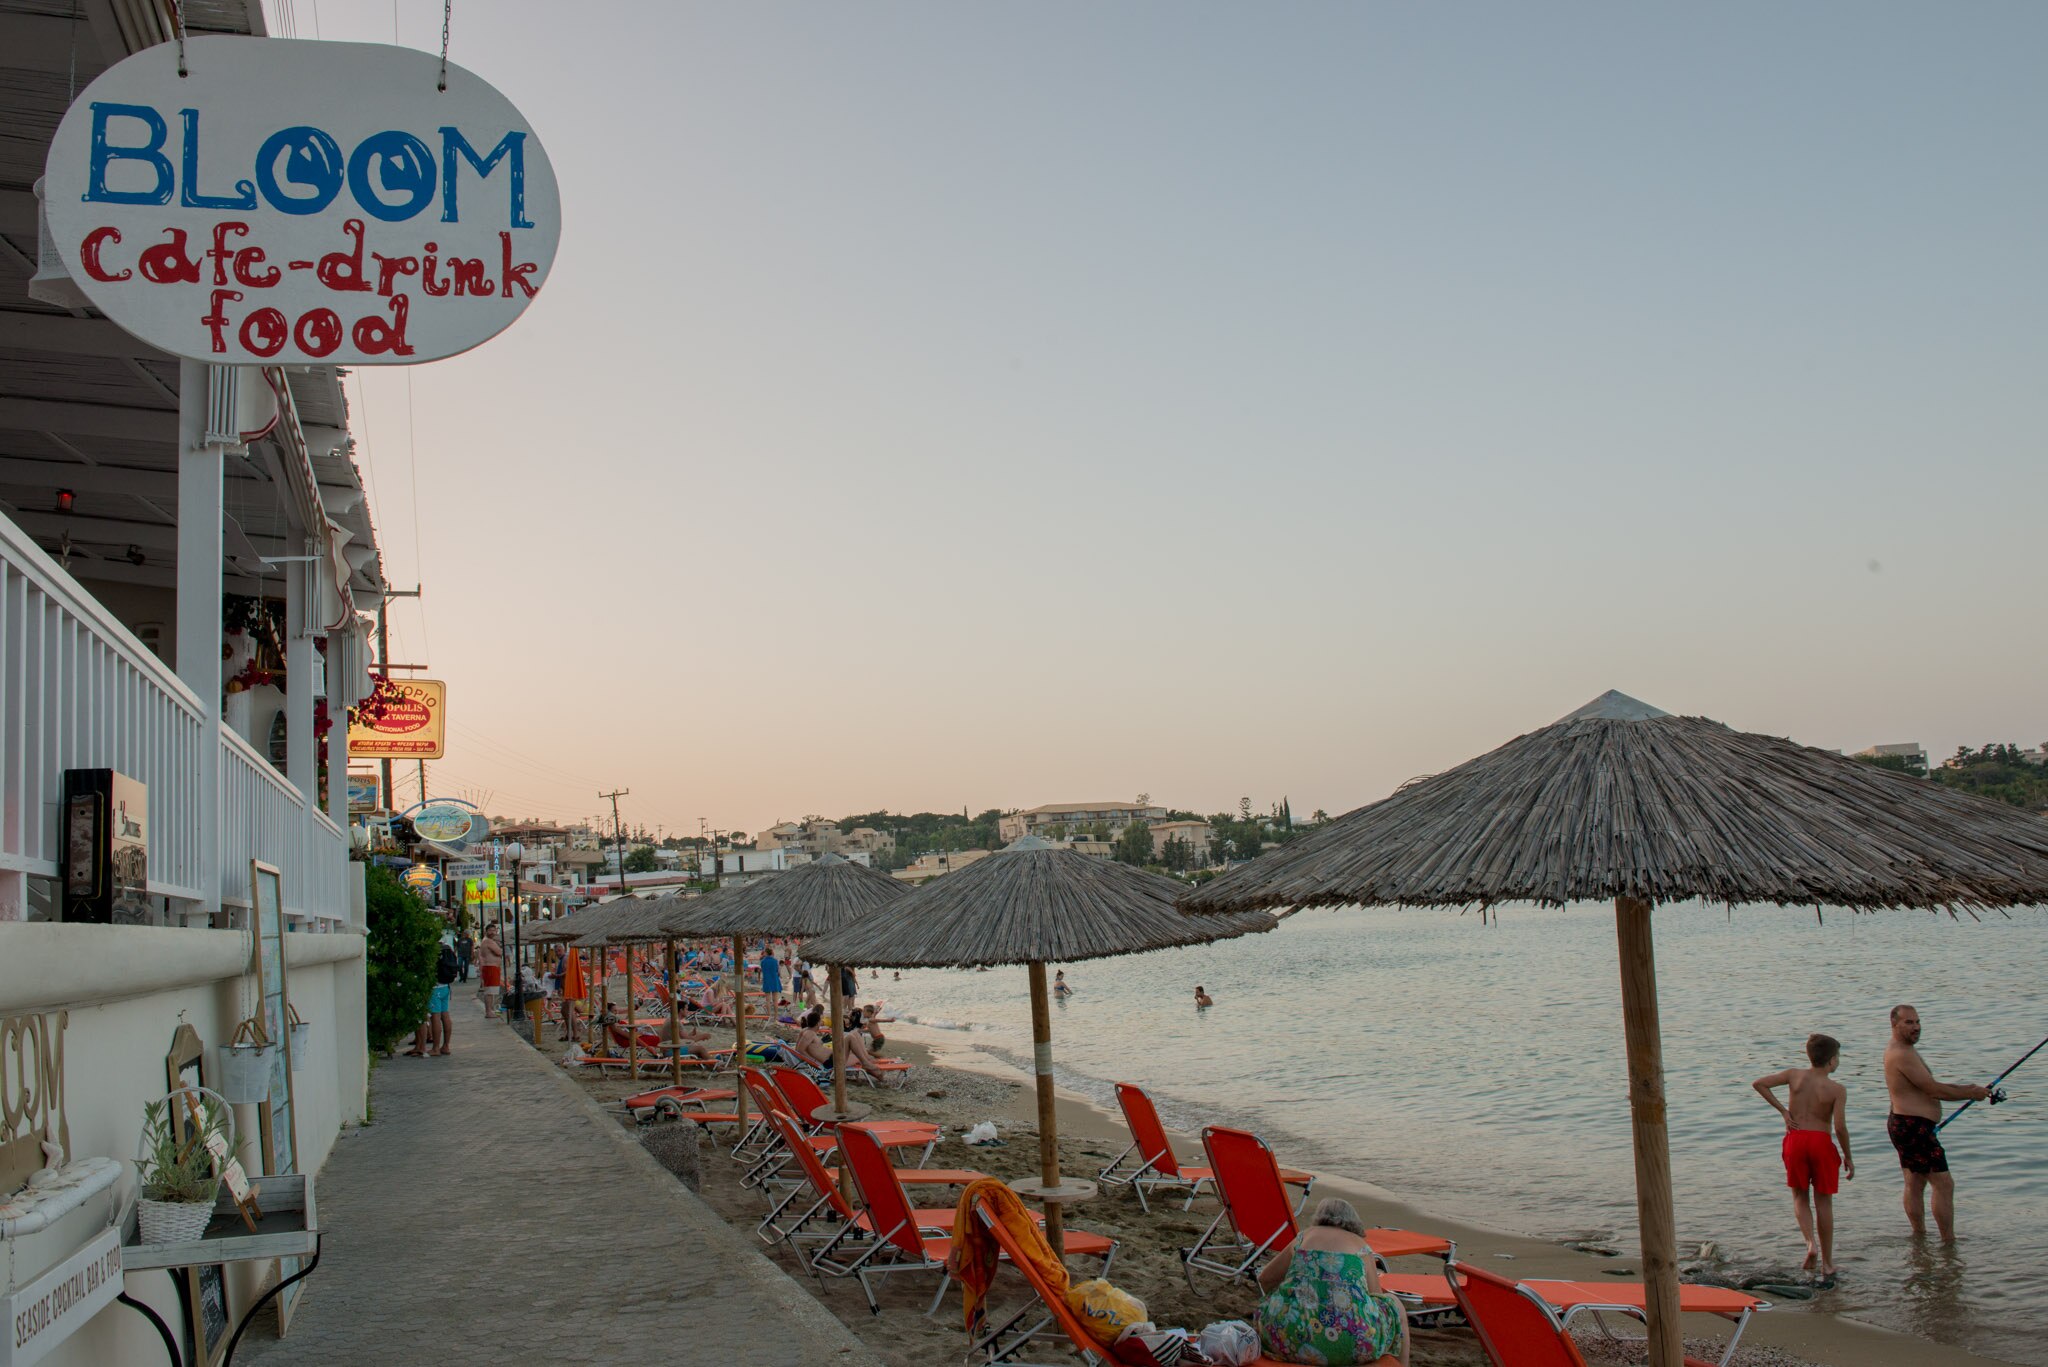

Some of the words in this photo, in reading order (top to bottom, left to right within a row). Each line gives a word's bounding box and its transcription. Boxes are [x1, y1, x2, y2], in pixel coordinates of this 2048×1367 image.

[81, 101, 535, 229] BLOOM
[201, 289, 416, 357] food
[373, 724, 404, 733] ADITIONAL
[405, 722, 421, 732] FOOD
[377, 703, 423, 712] OPOLIS
[391, 713, 427, 721] TAVERNA
[466, 889, 496, 901] NANU
[0, 1008, 70, 1140] OOM
[16, 1294, 51, 1349] SEASIDE
[53, 1269, 86, 1320] COCKTAIL
[87, 1261, 100, 1295] BAR
[101, 1256, 106, 1284] &
[106, 1244, 121, 1280] FOOD
